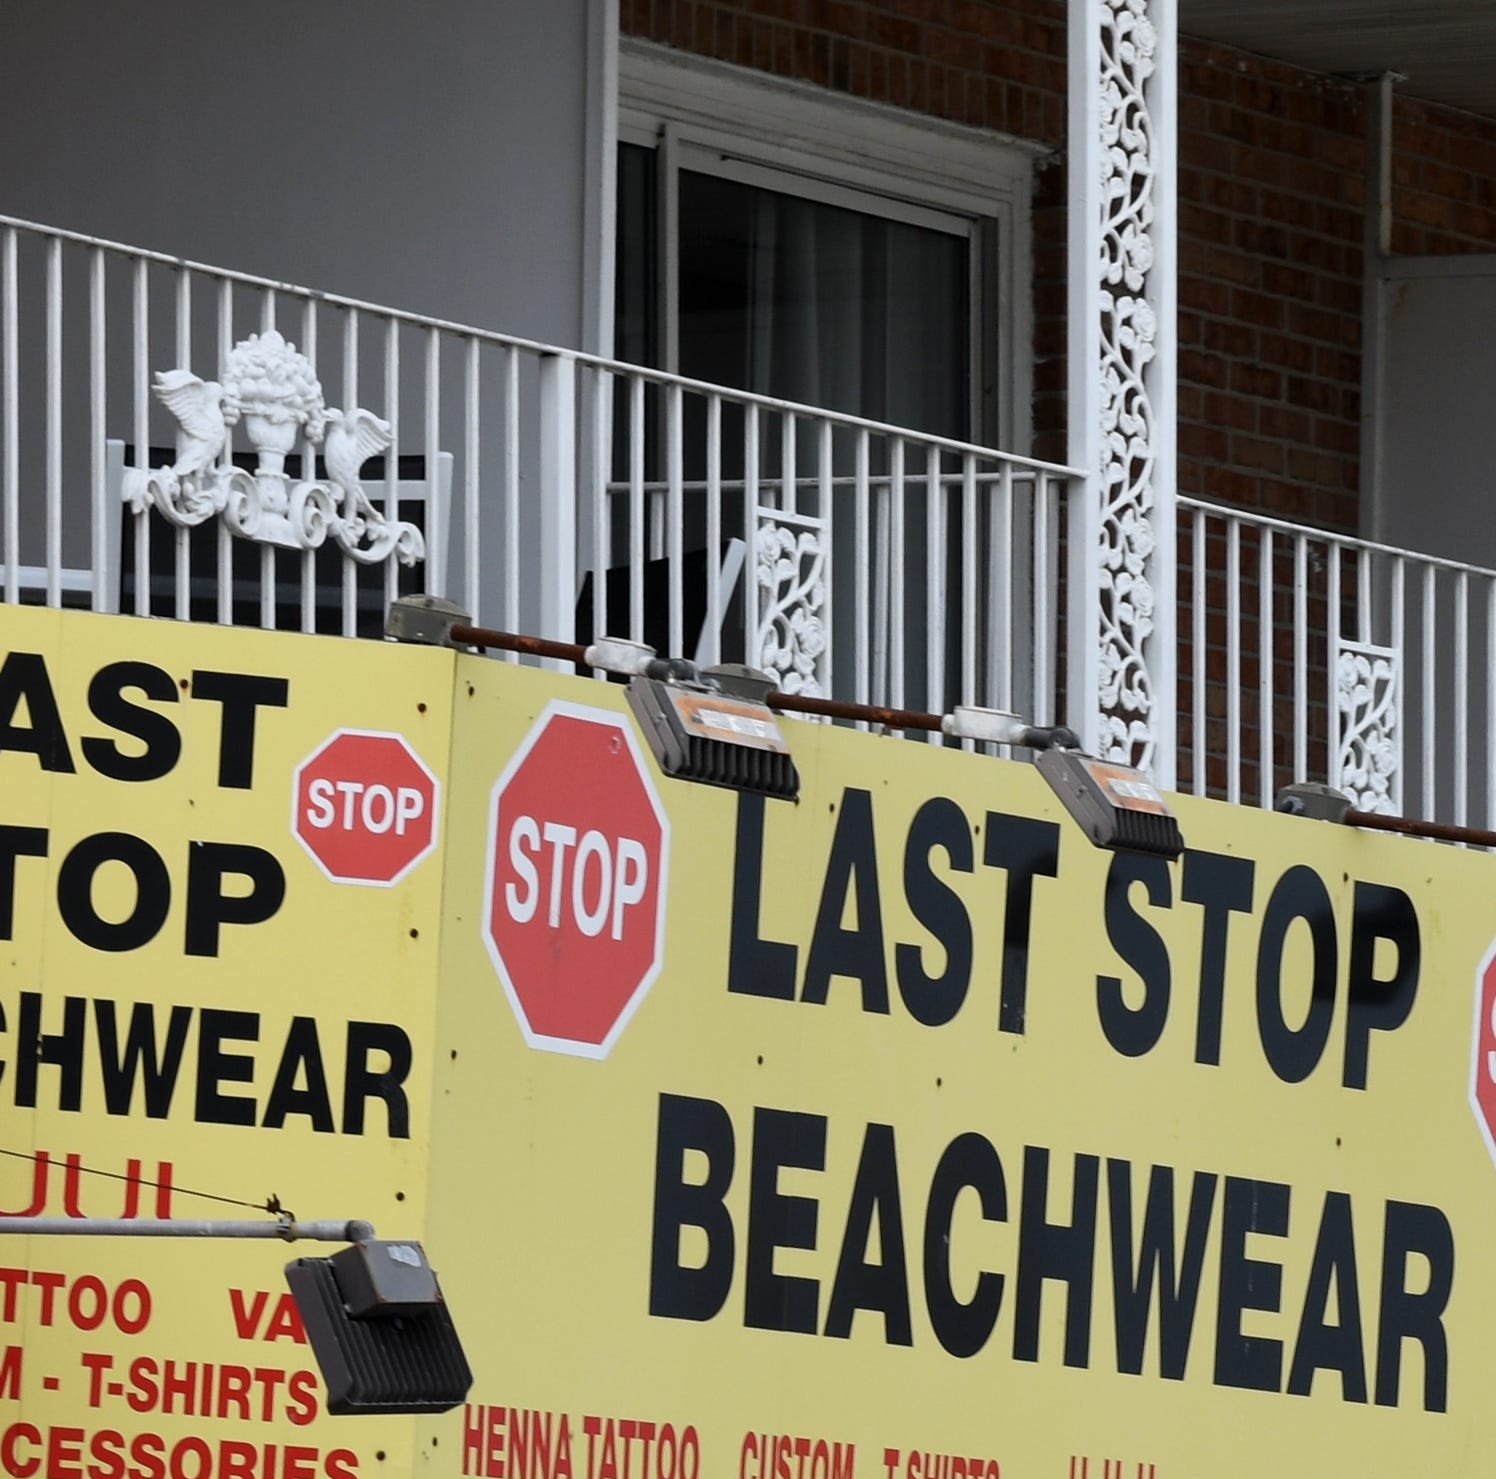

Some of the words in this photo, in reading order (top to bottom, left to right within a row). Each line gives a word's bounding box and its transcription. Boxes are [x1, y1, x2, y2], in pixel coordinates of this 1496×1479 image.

[307, 778, 424, 835] STOP
[505, 816, 647, 941] STOP
[727, 786, 1060, 1035] LAST
[1096, 848, 1420, 1089] STOP
[649, 1093, 1456, 1413] BEACHWEAR
[82, 1353, 318, 1425] T-SHIRTS
